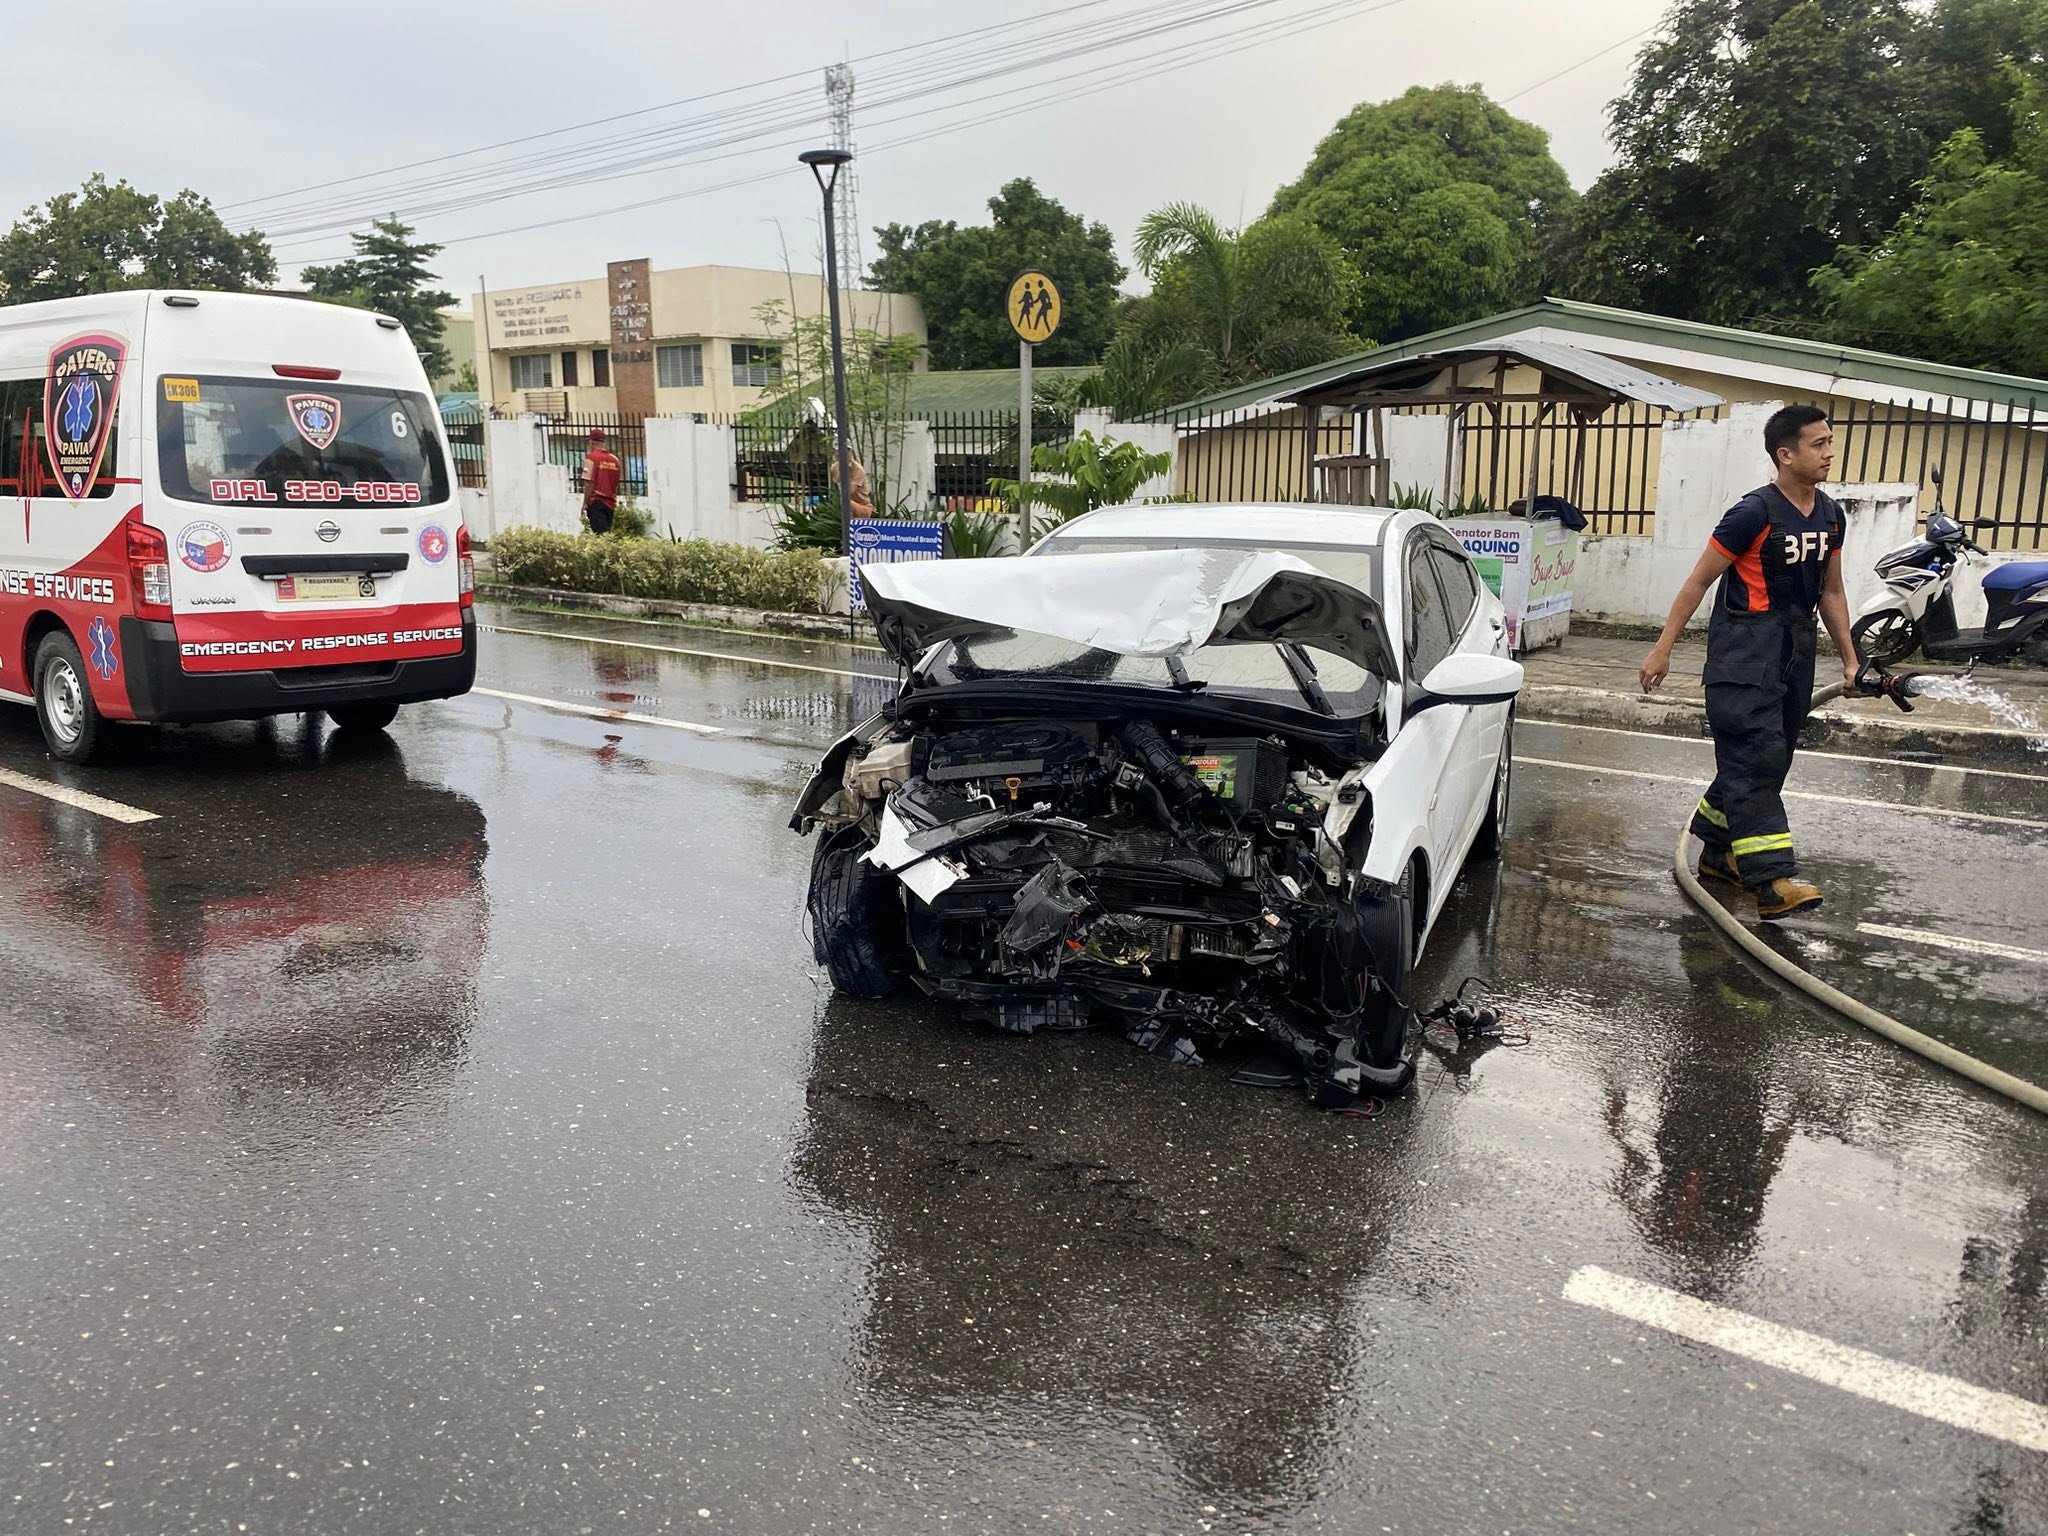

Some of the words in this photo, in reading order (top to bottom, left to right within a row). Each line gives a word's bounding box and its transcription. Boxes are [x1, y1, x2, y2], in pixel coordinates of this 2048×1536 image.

[56, 349, 116, 386] PAVERS
[295, 400, 334, 412] PAVERS
[391, 412, 408, 438] 6
[62, 442, 89, 455] PAVIA
[60, 456, 93, 465] EMERGENCY
[210, 480, 278, 501] DIAL
[285, 480, 421, 502] 320-3056
[896, 535, 918, 543] Trusted
[1494, 529, 1520, 539] Bam
[1463, 540, 1520, 554] AQUINO
[34, 572, 114, 604] SERVICES
[191, 596, 236, 605] URVAN
[181, 639, 295, 656] EMERGENCY
[301, 633, 388, 651] RESPONSE
[392, 627, 463, 644] SERVICES
